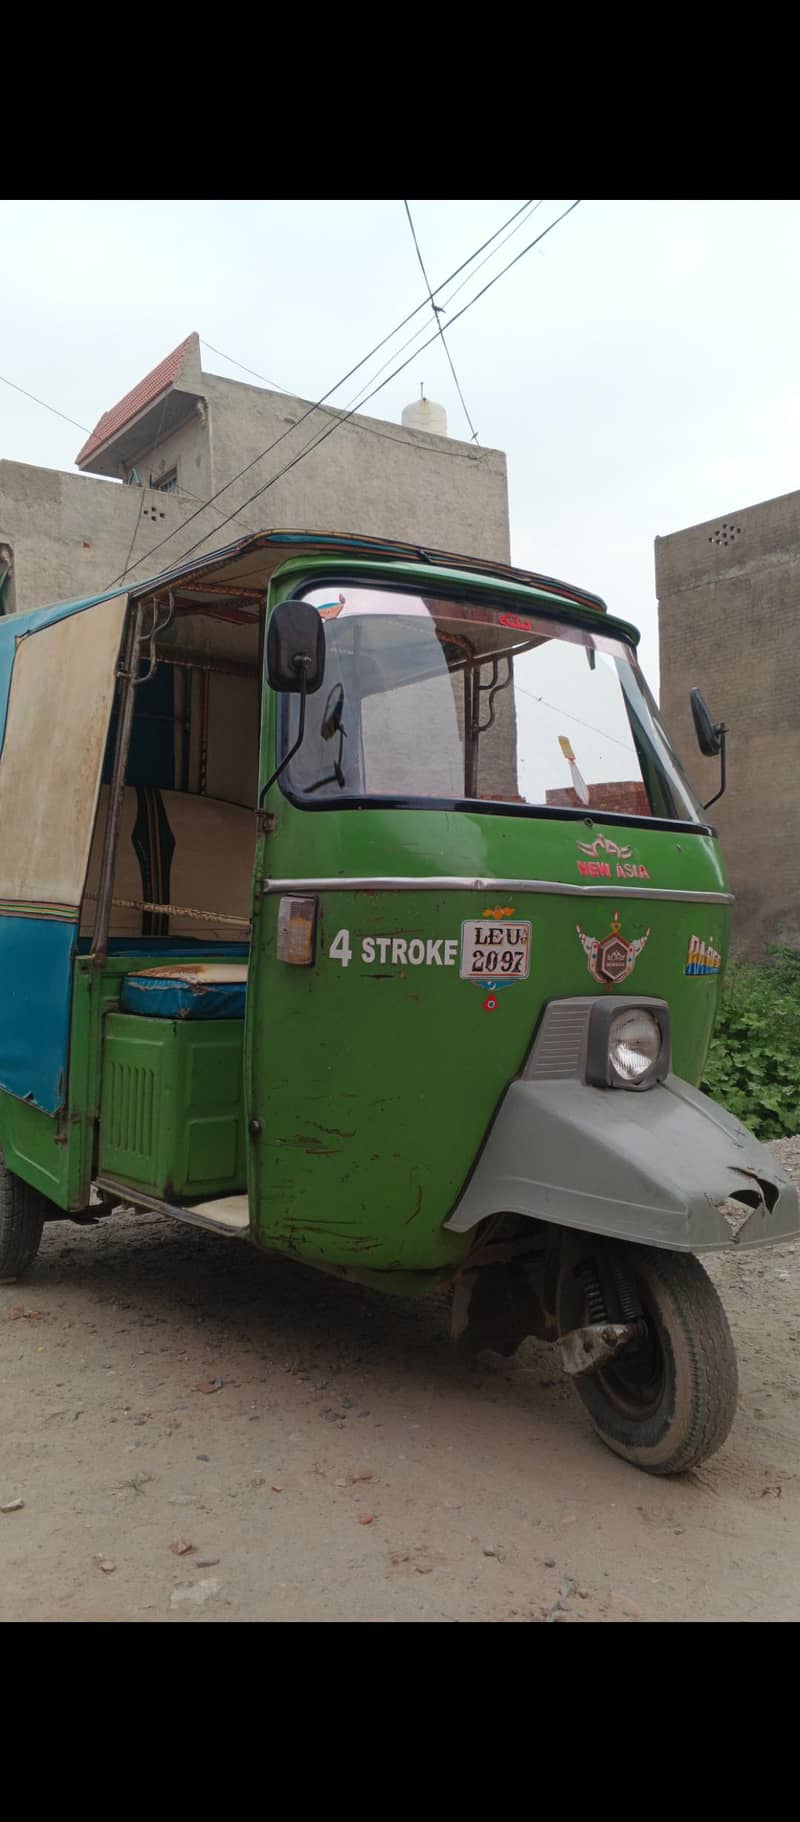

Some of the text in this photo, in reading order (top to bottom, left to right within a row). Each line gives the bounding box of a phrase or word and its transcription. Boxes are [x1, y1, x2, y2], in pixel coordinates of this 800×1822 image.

[577, 860, 650, 880] NEW ASIA
[474, 927, 521, 945] LEU
[329, 928, 459, 967] 4 STROKE
[471, 950, 524, 973] 2097
